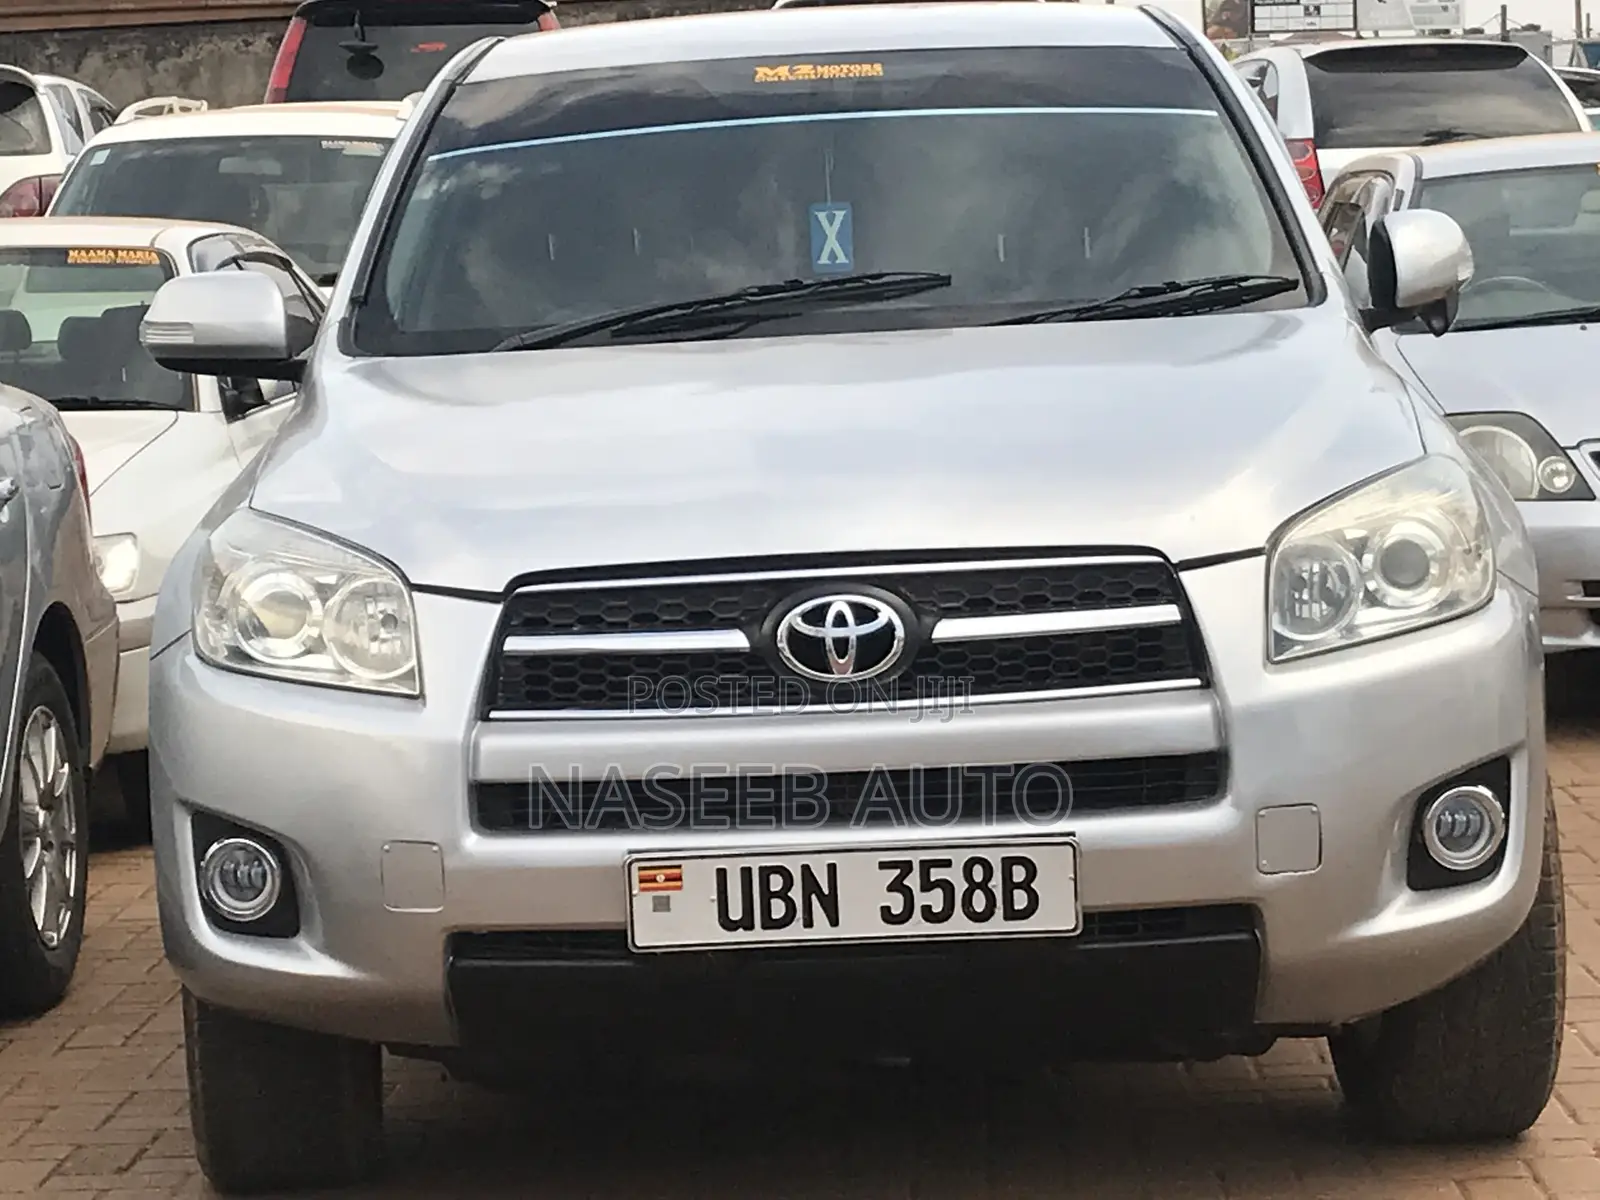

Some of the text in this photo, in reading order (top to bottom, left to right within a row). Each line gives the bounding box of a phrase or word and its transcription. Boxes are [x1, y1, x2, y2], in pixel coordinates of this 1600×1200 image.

[817, 64, 882, 75] MOTORS
[814, 210, 849, 264] X
[716, 855, 1040, 932] UBN 358B
